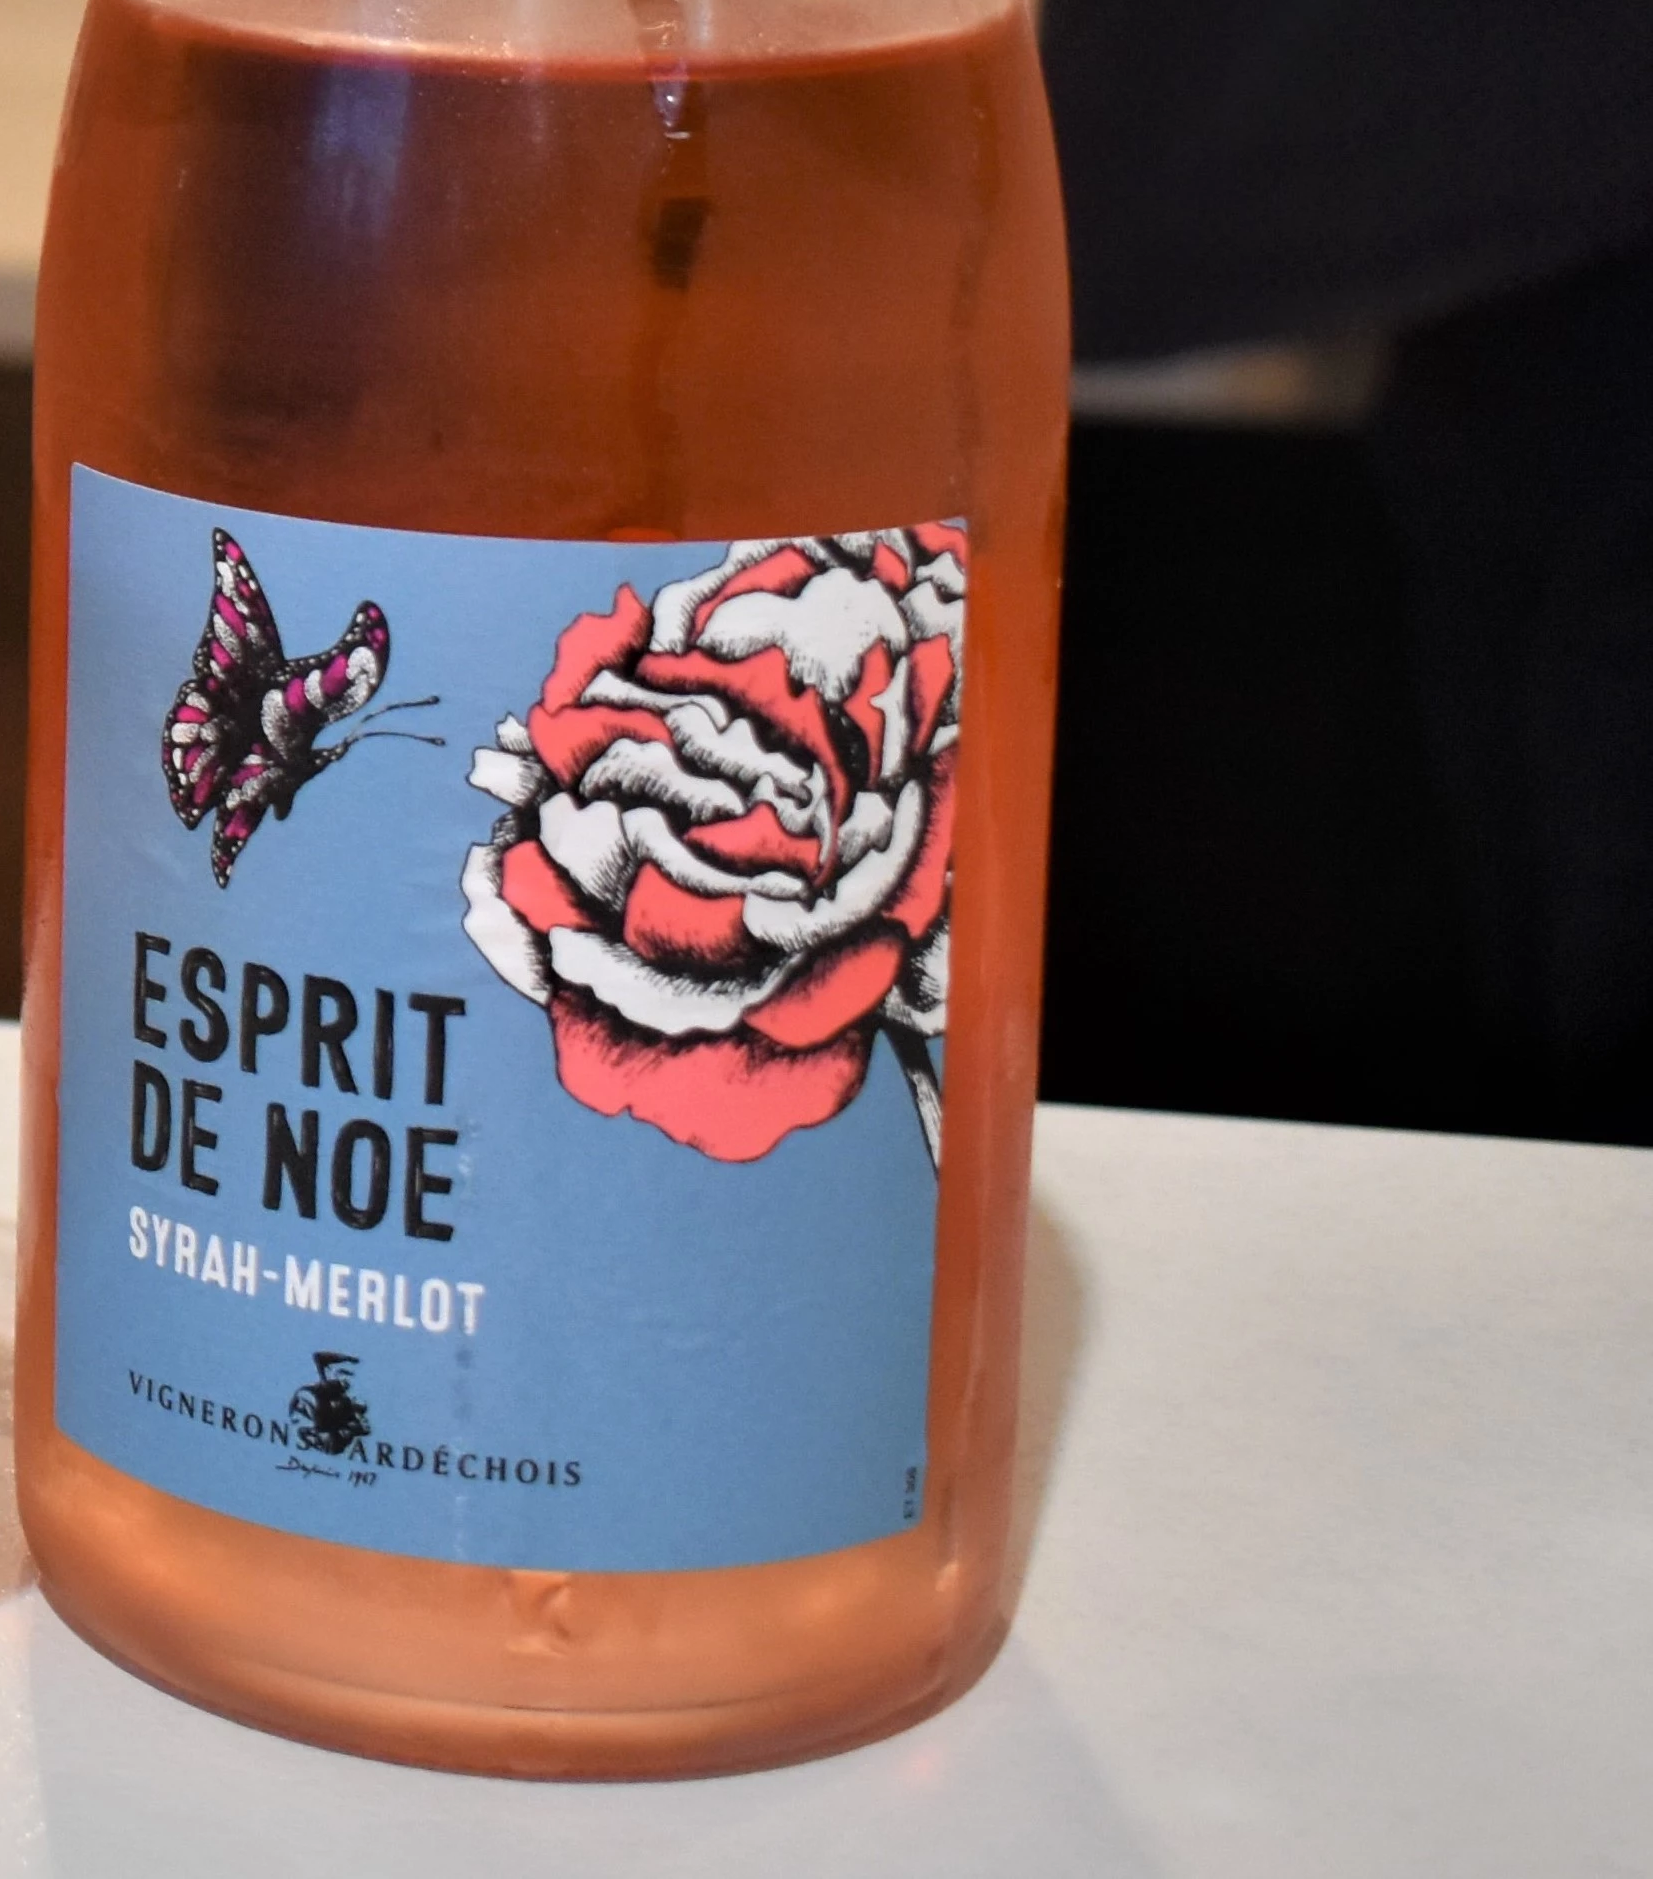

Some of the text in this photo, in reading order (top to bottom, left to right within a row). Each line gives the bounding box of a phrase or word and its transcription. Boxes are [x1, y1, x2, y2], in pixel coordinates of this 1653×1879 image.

[133, 931, 467, 1106] ESPRIT
[130, 1059, 459, 1242] DE NOE
[127, 1205, 487, 1337] SYRAH-MERLOT
[127, 1368, 583, 1487] VIGNERONS ARDÉCHOIS
